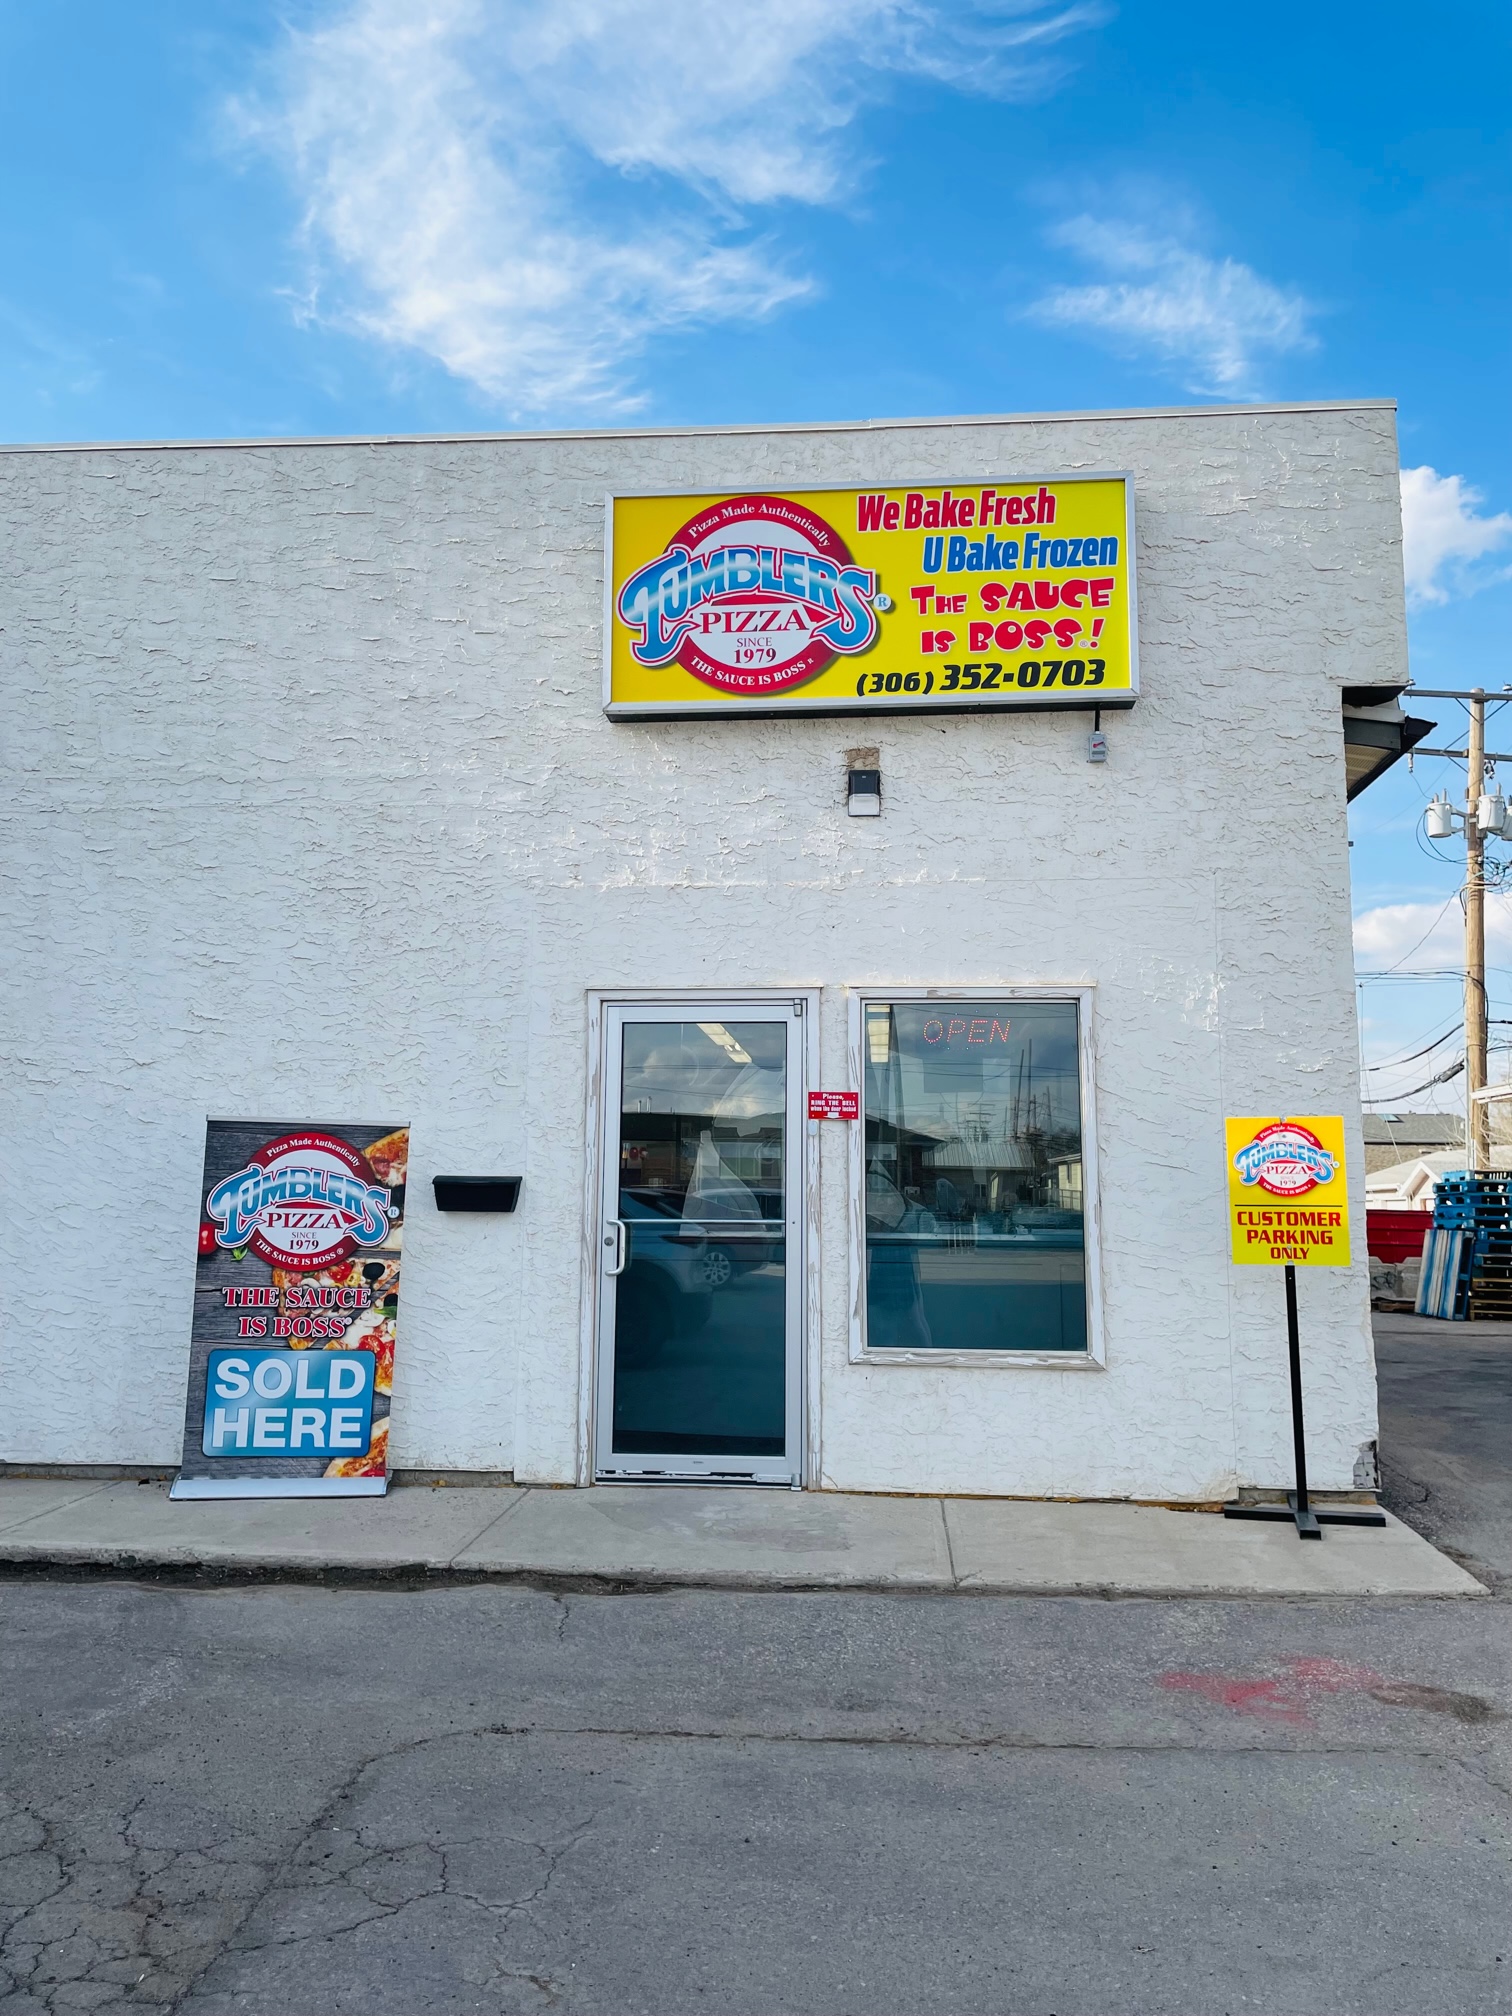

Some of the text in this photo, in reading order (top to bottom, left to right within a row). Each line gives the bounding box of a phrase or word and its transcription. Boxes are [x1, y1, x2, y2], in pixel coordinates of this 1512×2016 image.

[858, 487, 1056, 531] We Bake Fresh
[688, 503, 830, 547] Pizza Made Authentically
[923, 532, 1119, 574] U Bake Frozen
[980, 578, 1115, 612] SAUCE
[699, 609, 809, 634] PIZZA
[736, 636, 772, 647] SINCE
[921, 630, 956, 653] IS
[734, 648, 777, 664] 1979
[690, 656, 806, 686] THE SAUCE IS BOSS
[856, 659, 1106, 697] (306) 352-0703
[923, 1019, 1011, 1043] OPEN
[266, 1138, 360, 1167] Pizza Made Authentically
[1266, 1165, 1308, 1174] PIZZA
[267, 1212, 343, 1229] PIZZA
[1237, 1211, 1341, 1226] CUSTOMER
[289, 1239, 319, 1250] 1979
[291, 1231, 317, 1239] SINCE
[1247, 1229, 1333, 1245] PARKING
[256, 1238, 272, 1254] THE
[272, 1250, 299, 1265] SAUCE
[313, 1252, 336, 1265] BOSS
[1270, 1247, 1310, 1259] ONLY
[222, 1286, 371, 1308] THE SAUCE
[238, 1316, 346, 1338] IS BOSS
[214, 1358, 366, 1399] SOLD
[212, 1408, 364, 1448] HERE
